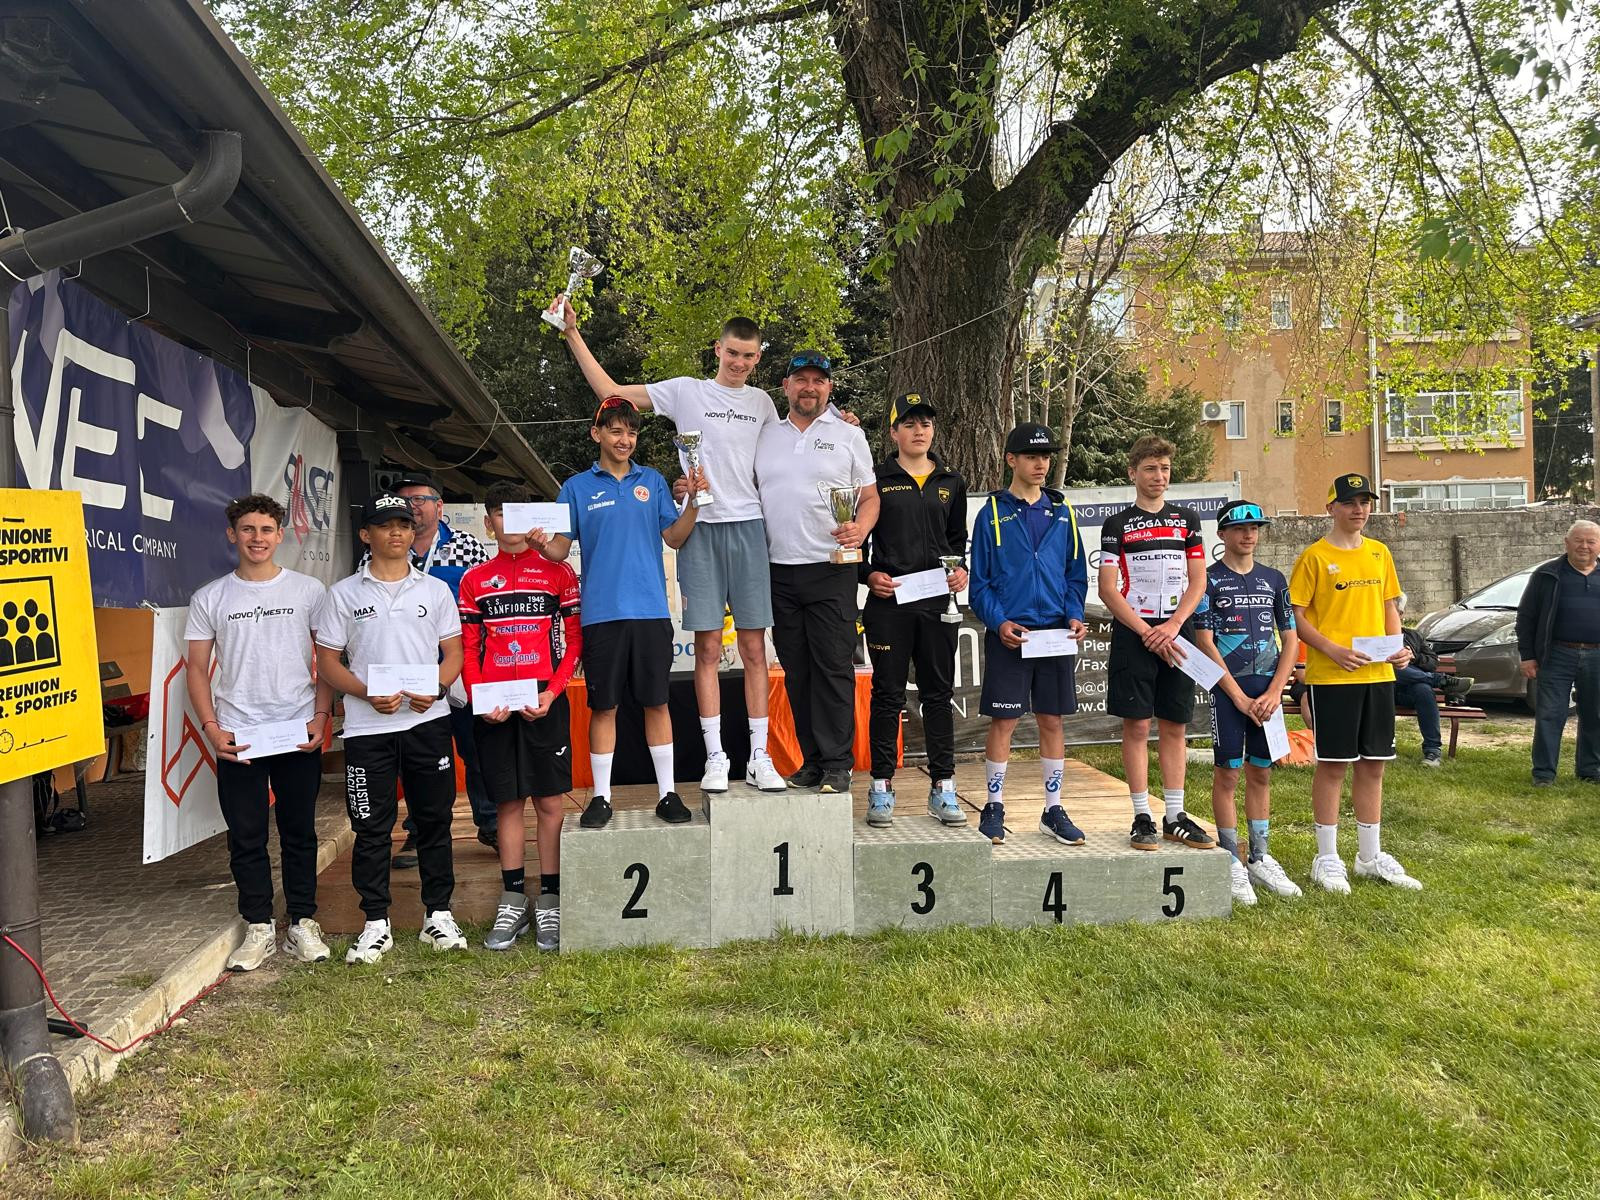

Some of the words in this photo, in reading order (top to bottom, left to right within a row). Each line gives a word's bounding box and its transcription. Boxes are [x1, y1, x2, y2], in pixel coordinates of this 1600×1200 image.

[704, 411, 726, 419] NOVO
[733, 413, 757, 423] MESTO
[881, 485, 913, 493] GIVOVA
[1073, 506, 1096, 520] NO
[1187, 500, 1224, 514] GIULIA
[1123, 518, 1162, 534] SLOGA
[1163, 518, 1187, 528] 1902
[0, 528, 52, 546] NIONE
[1124, 530, 1153, 542] IDRIJA
[132, 534, 178, 560] CMPANY
[1131, 553, 1182, 562] KOLEKTOR
[527, 595, 545, 603] 1945
[227, 612, 254, 622] NOVO
[262, 607, 294, 617] MESTO
[353, 605, 376, 618] MAX
[488, 602, 545, 616] SANFIORESE
[495, 624, 539, 634] PENETRON
[493, 651, 540, 664] Casagrande
[1074, 658, 1108, 673] /Fax
[15, 689, 78, 716] SPORTIFS
[992, 702, 1022, 710] GIVOVA
[354, 766, 371, 820] CICLISTICA
[772, 841, 795, 896] 1
[621, 862, 650, 920] 2
[910, 861, 937, 916] 3
[1161, 866, 1186, 918] 5
[1041, 871, 1068, 925] 4
